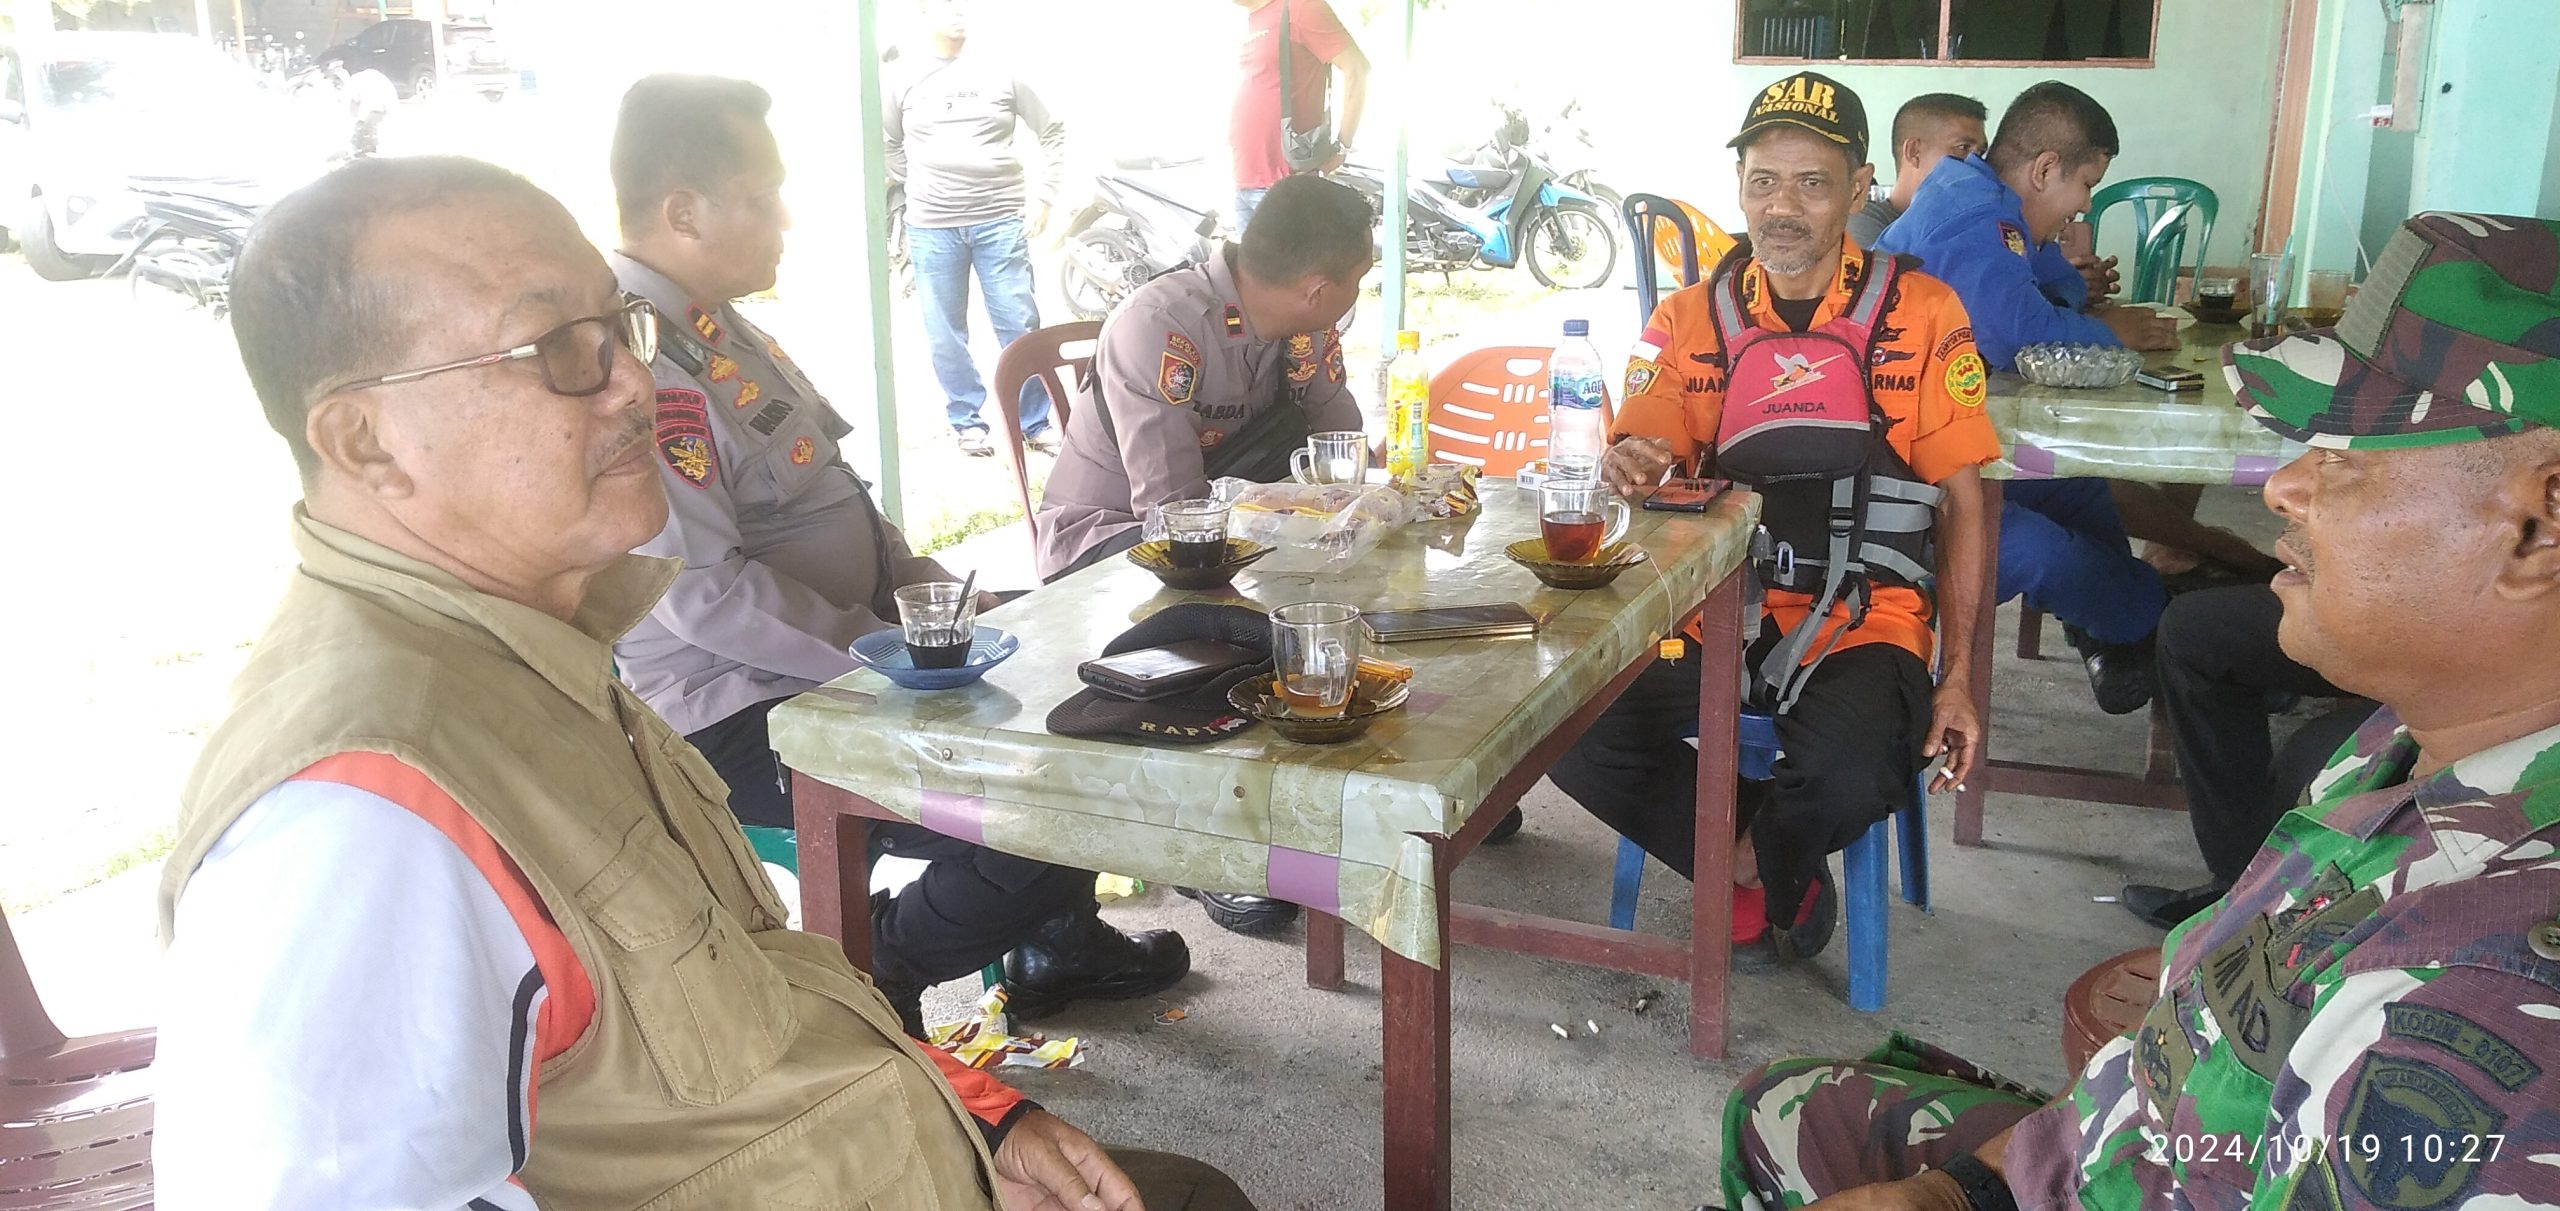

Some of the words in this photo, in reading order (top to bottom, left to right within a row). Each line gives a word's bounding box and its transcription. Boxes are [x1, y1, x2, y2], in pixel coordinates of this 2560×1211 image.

[1762, 77, 1835, 109] SAR
[1752, 101, 1839, 124] NASIONAL
[1762, 402, 1827, 414] JUANDA
[2228, 981, 2270, 1053] AD
